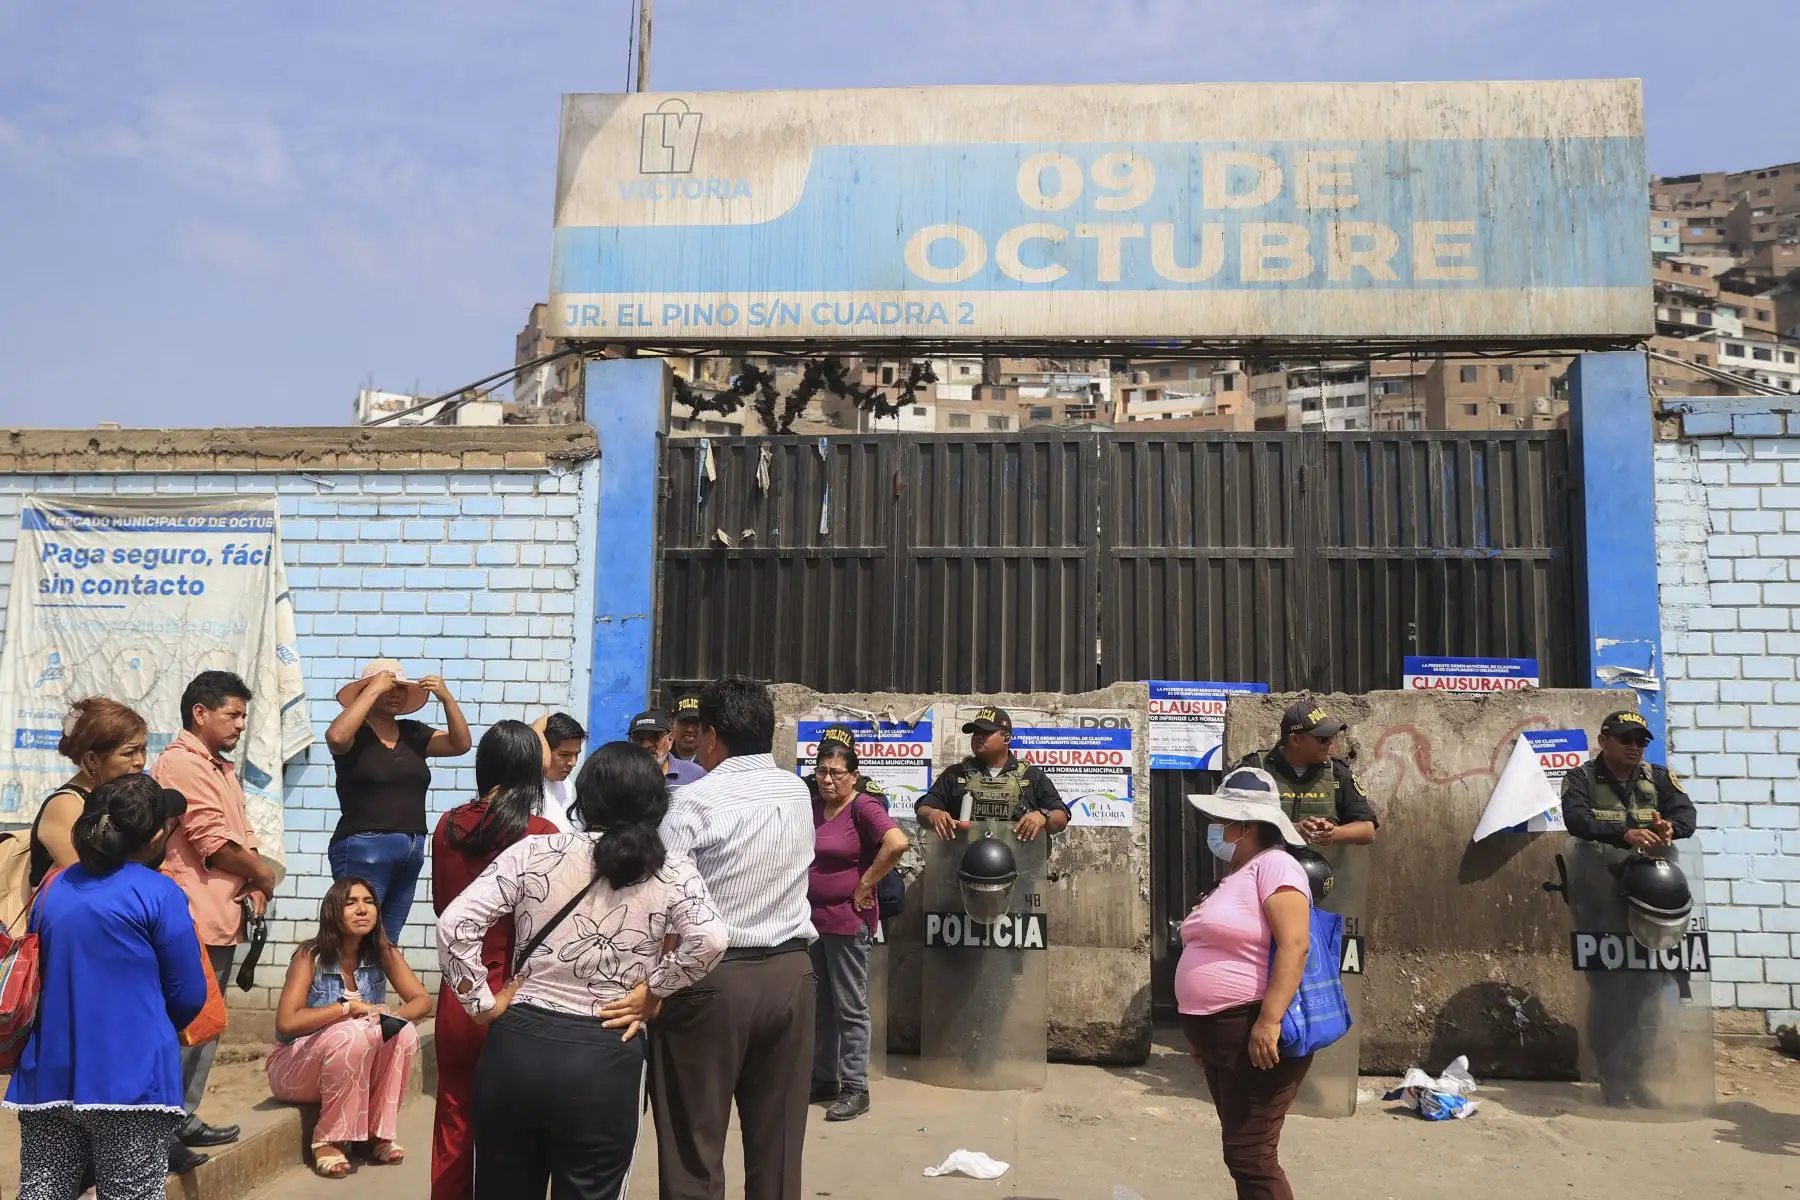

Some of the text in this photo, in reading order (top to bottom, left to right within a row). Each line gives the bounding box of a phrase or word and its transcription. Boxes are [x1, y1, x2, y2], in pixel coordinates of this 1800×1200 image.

[618, 177, 752, 201] VICTORIA
[1016, 149, 1359, 212] 09 DE
[904, 221, 1479, 283] OCTUBRE
[566, 299, 975, 328] JR. EL PINO S/N CUADRA 2
[48, 515, 272, 528] MERCADO MUNICIPAL 09 DE OCTUB
[42, 543, 271, 570] Paga seguro, fáci
[39, 573, 205, 596] sin contacto
[1412, 676, 1530, 691] CLAUSURADO
[679, 698, 699, 711] POLIC
[1149, 700, 1224, 715] CLAUSUR
[976, 708, 996, 722] LICIA
[806, 743, 924, 758] CSURADO
[1014, 750, 1123, 766] AUSURADO
[976, 803, 1008, 816] POLICIA
[926, 914, 1044, 948] POLICIA
[1576, 934, 1707, 970] POLICIA
